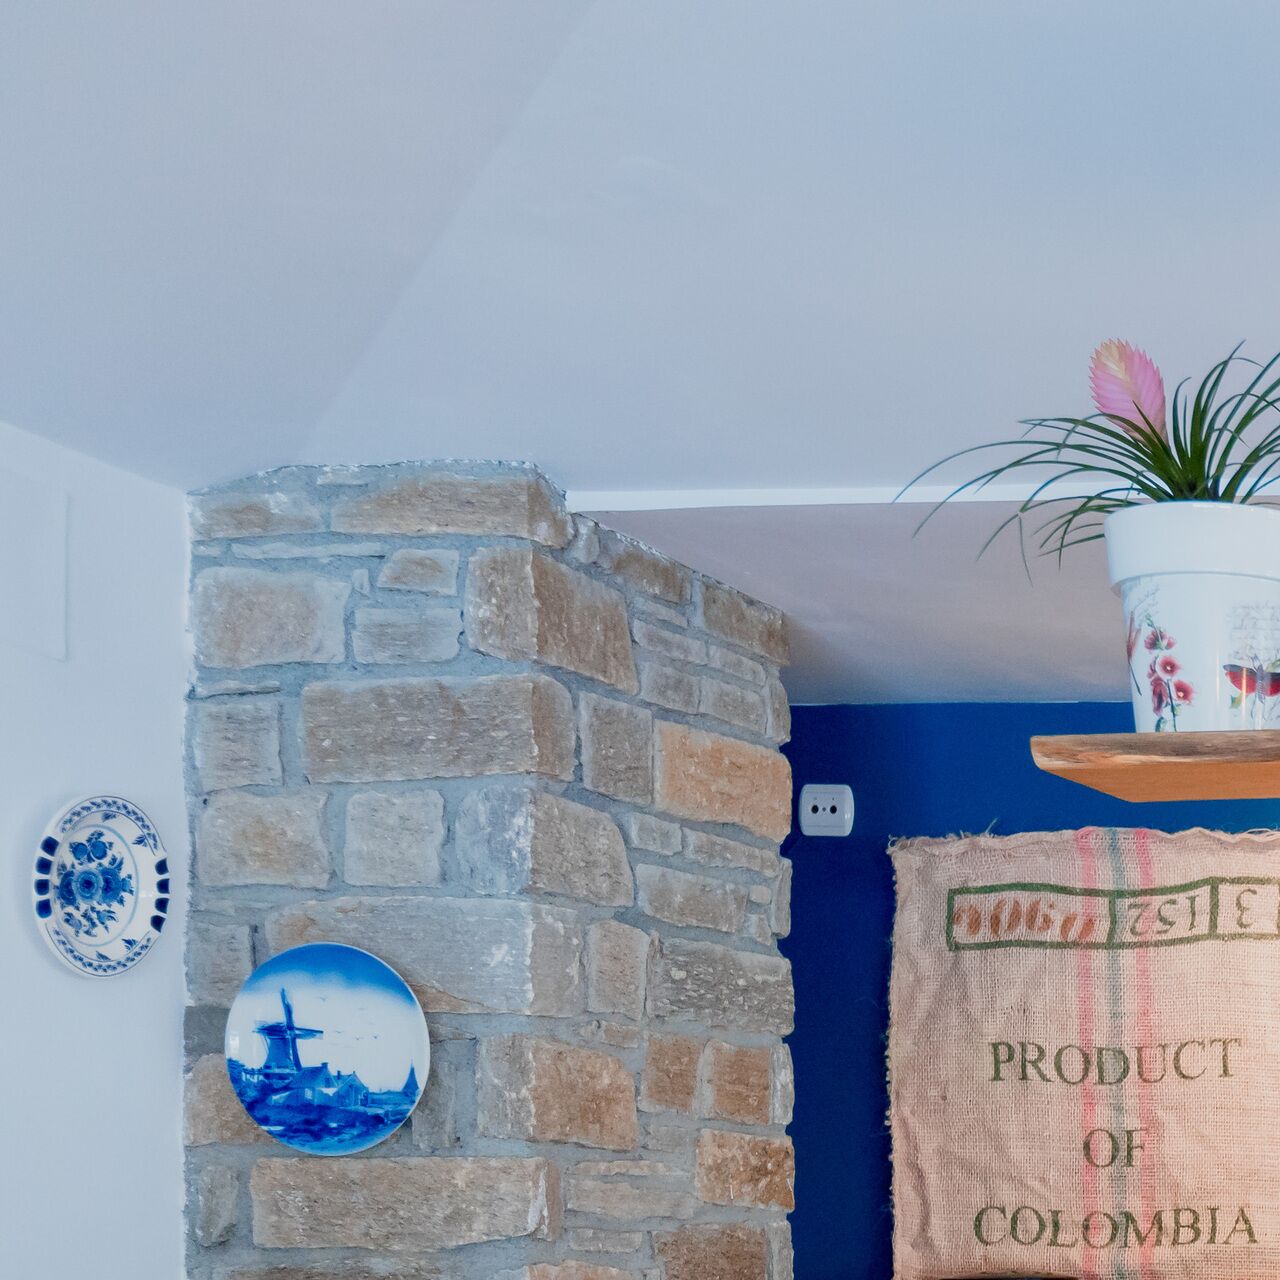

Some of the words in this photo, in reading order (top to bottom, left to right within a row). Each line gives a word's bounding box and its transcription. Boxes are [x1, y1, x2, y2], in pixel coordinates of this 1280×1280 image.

[989, 1037, 1242, 1088] PRODUCT
[1083, 1128, 1146, 1168] OF
[973, 1204, 1259, 1250] COLOMBIA
